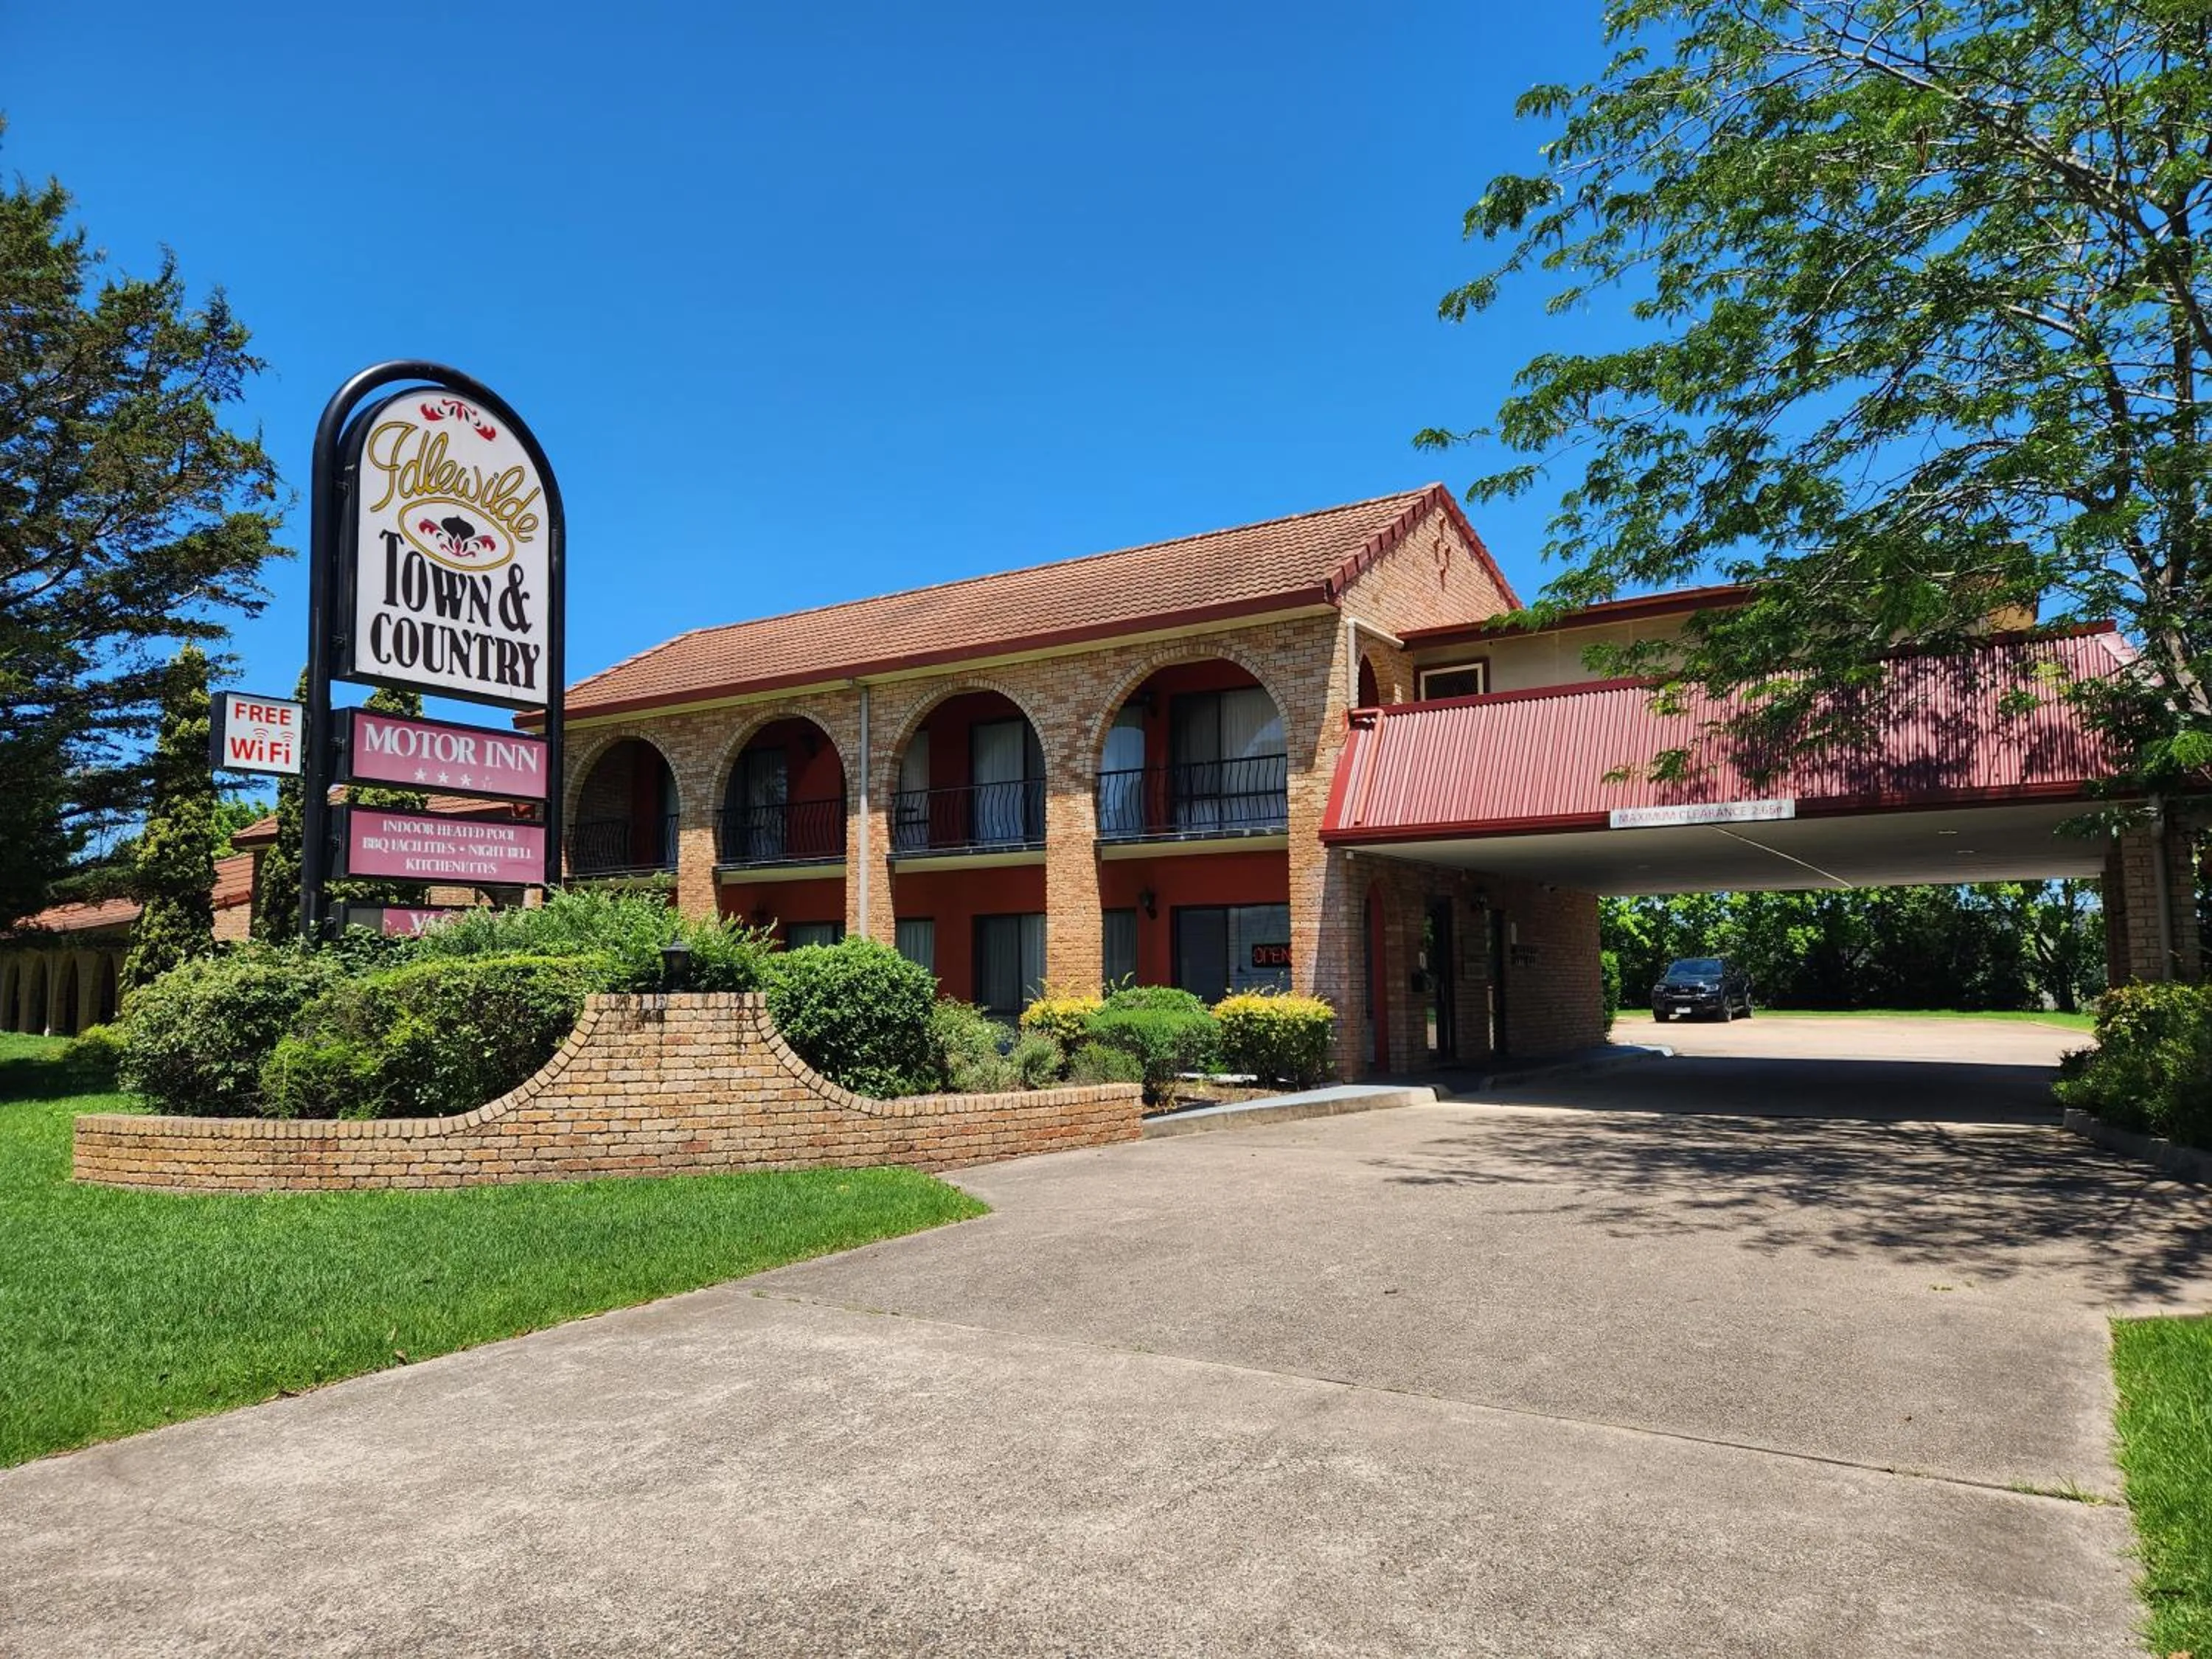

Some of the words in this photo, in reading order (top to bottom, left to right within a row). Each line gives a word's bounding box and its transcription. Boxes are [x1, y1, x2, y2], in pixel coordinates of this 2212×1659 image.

[369, 421, 540, 542] Idlewilde
[379, 529, 492, 628] TOWN
[499, 563, 532, 634] &
[370, 612, 540, 690] COUNTRY
[234, 702, 292, 726] FREE
[364, 723, 477, 766] MOTOR
[485, 740, 539, 773] INN
[1679, 806, 1747, 821] CLEARANCE
[383, 819, 434, 836] INDOOR
[437, 824, 484, 838] HEATED
[486, 827, 515, 841] POOL
[363, 837, 389, 854] BBQ
[392, 840, 455, 855] FACILITIES
[467, 844, 504, 858] NIGHT
[406, 857, 497, 874] KITCHENETTES
[1253, 946, 1292, 964] OPEN
